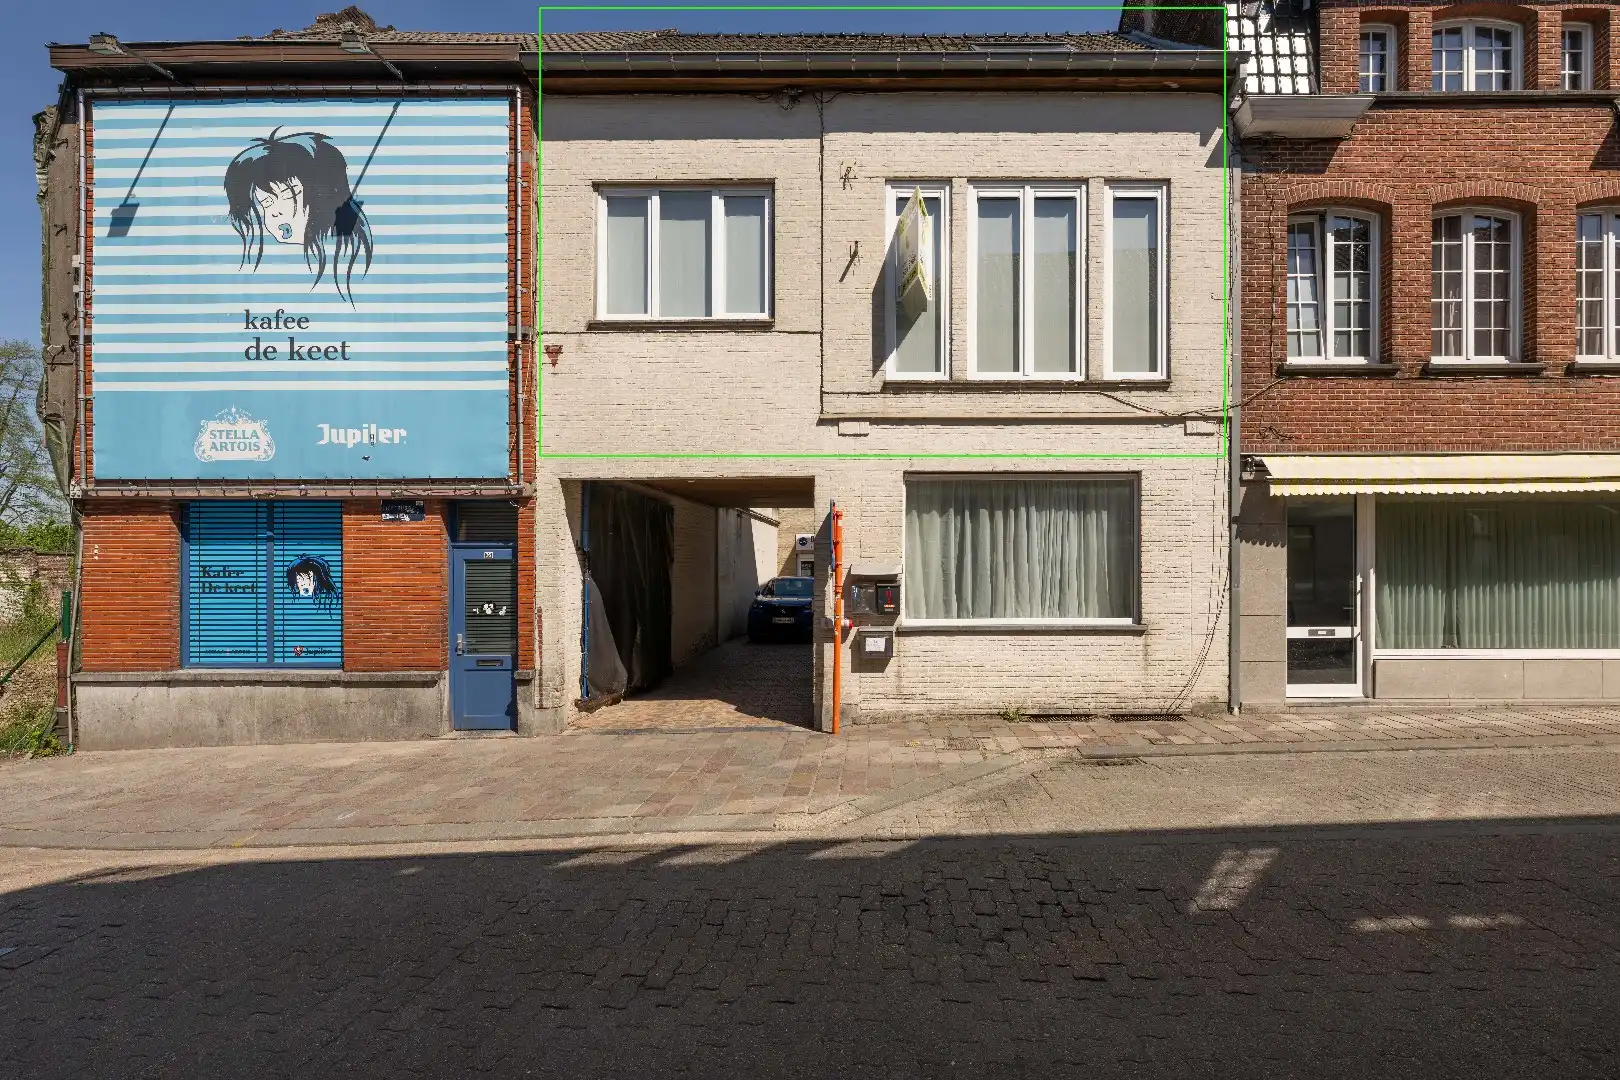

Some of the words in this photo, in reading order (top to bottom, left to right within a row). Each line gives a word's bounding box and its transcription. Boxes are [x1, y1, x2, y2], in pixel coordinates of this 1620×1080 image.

[244, 309, 310, 330] kafee
[244, 337, 278, 361] de
[287, 337, 351, 361] keet
[209, 429, 260, 440] STELLA
[316, 423, 407, 449] Jupiler
[209, 441, 261, 452] ARTOIS
